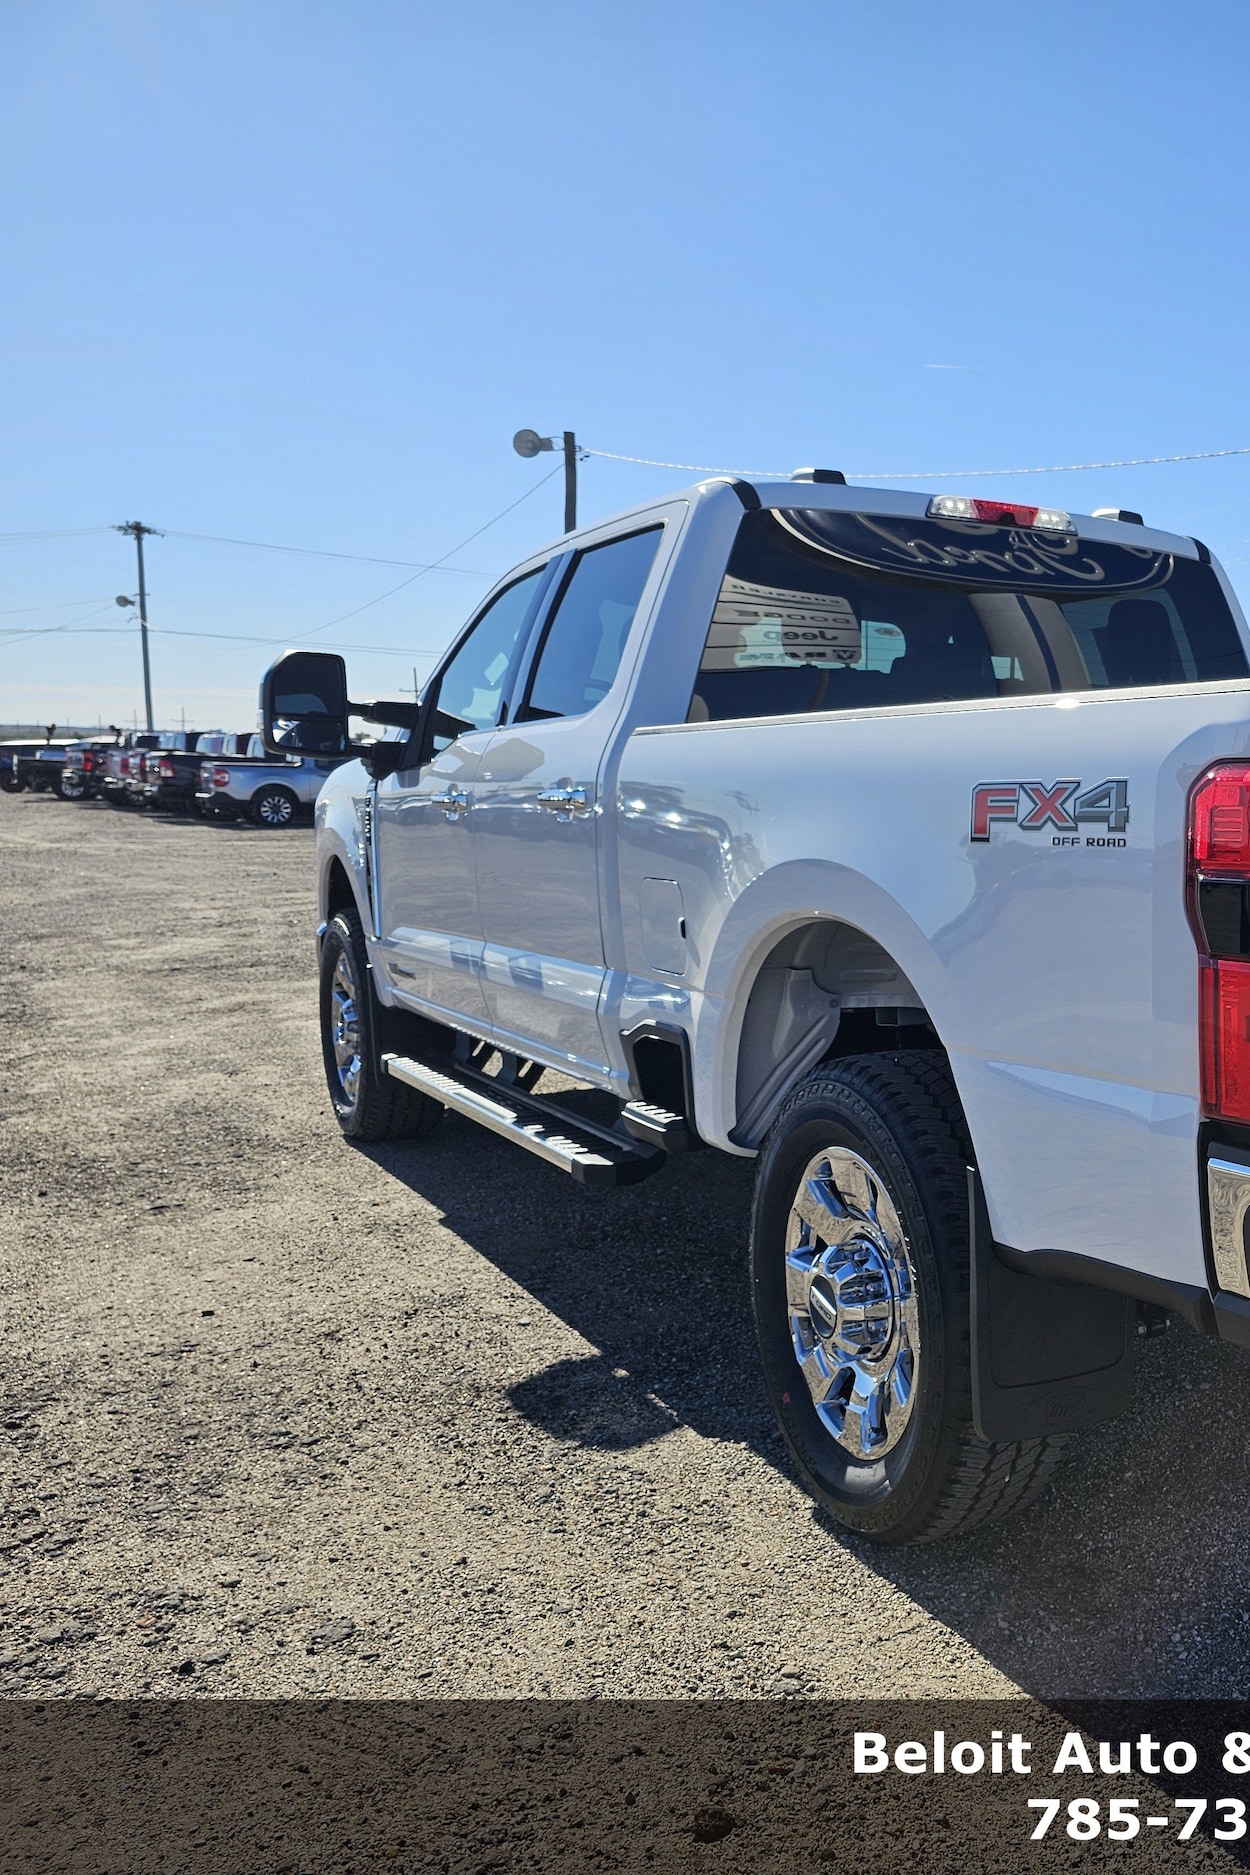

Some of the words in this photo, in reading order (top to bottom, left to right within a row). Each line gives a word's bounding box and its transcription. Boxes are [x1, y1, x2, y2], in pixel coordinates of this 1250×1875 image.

[970, 776, 1131, 843] FX4
[1052, 837, 1080, 847] OFF
[1086, 837, 1127, 848] ROAD
